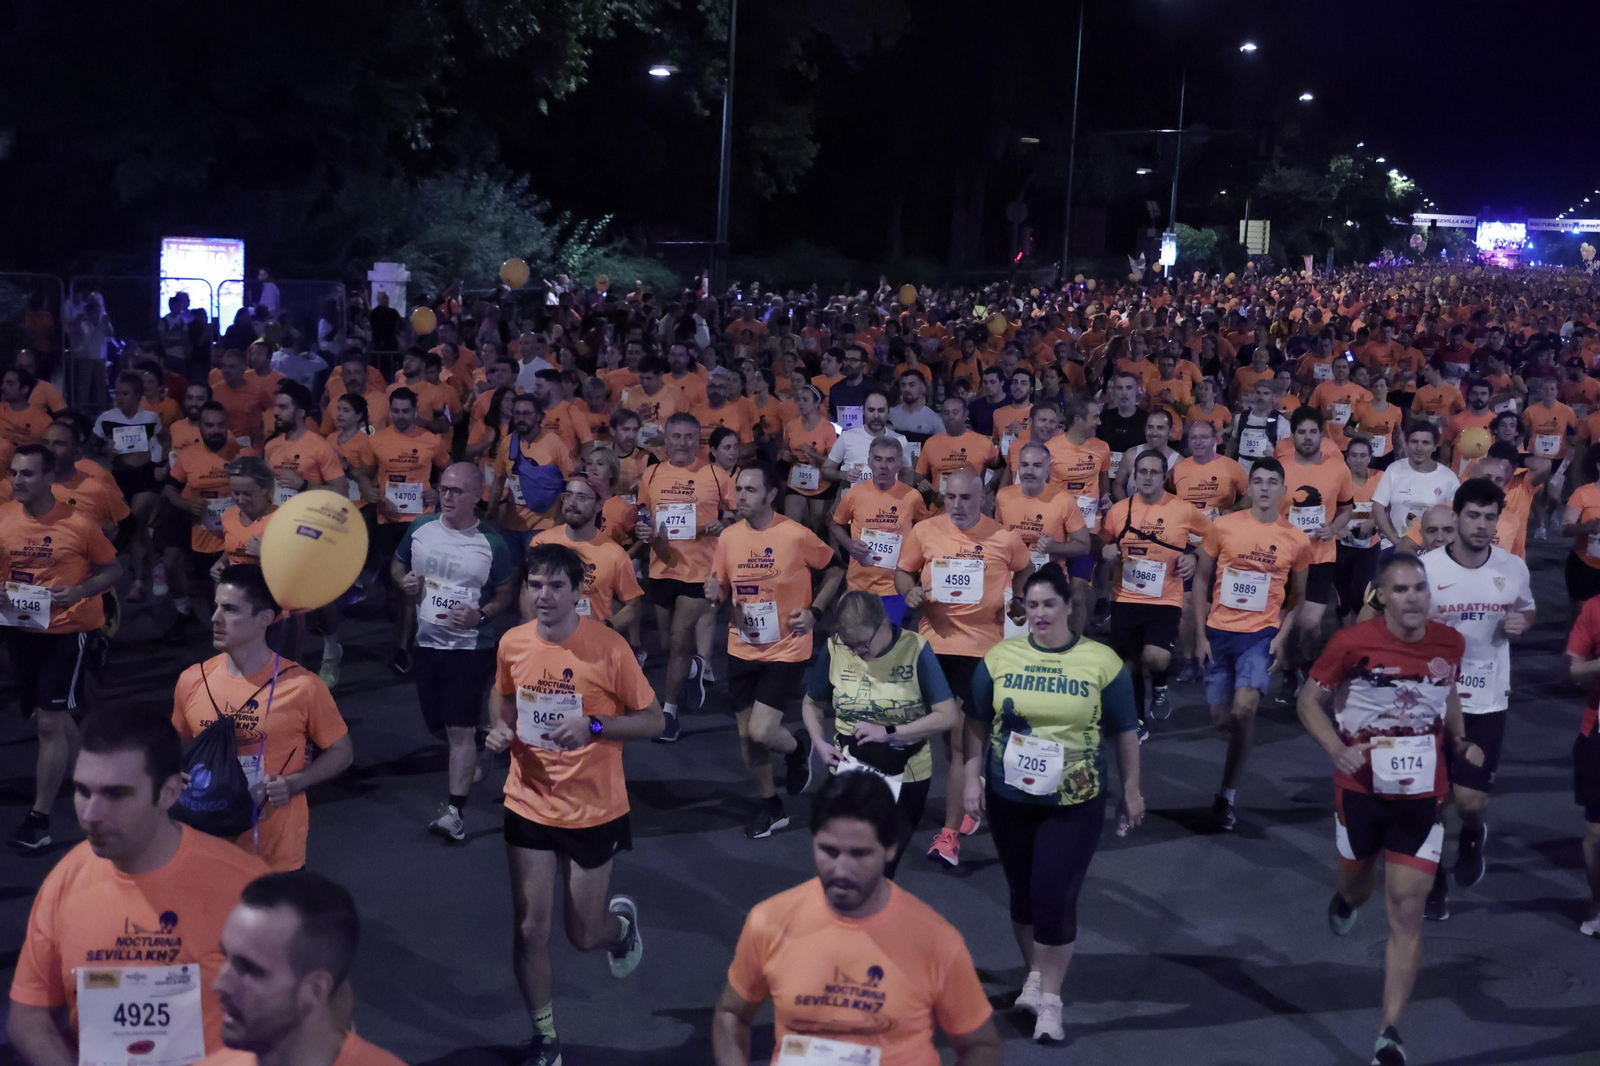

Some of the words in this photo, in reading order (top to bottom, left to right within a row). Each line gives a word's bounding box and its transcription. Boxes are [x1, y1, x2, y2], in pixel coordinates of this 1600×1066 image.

[394, 492, 417, 500] 14700
[666, 516, 686, 524] 4774
[1296, 516, 1320, 525] 19548
[868, 541, 894, 554] 21555
[945, 574, 971, 586] 4589
[1132, 570, 1156, 582] 13888
[1233, 582, 1257, 595] 9889
[11, 598, 40, 612] 11348
[744, 616, 765, 627] 4311
[1461, 612, 1485, 620] BET
[1024, 664, 1063, 674] RUNNERS
[537, 679, 576, 690] NOCTURNA
[1002, 673, 1090, 698] BARREÑOS
[236, 722, 258, 731] KH7
[1018, 754, 1047, 773] 7205
[1390, 756, 1423, 770] 6174
[116, 937, 182, 947] NOCTURNA
[86, 950, 142, 962] SEVILLA
[146, 949, 180, 962] KH7
[825, 984, 886, 1001] NOCTURNA
[794, 995, 850, 1008] SEVILLA
[852, 1000, 884, 1014] KH7
[113, 1002, 170, 1027] 4925
